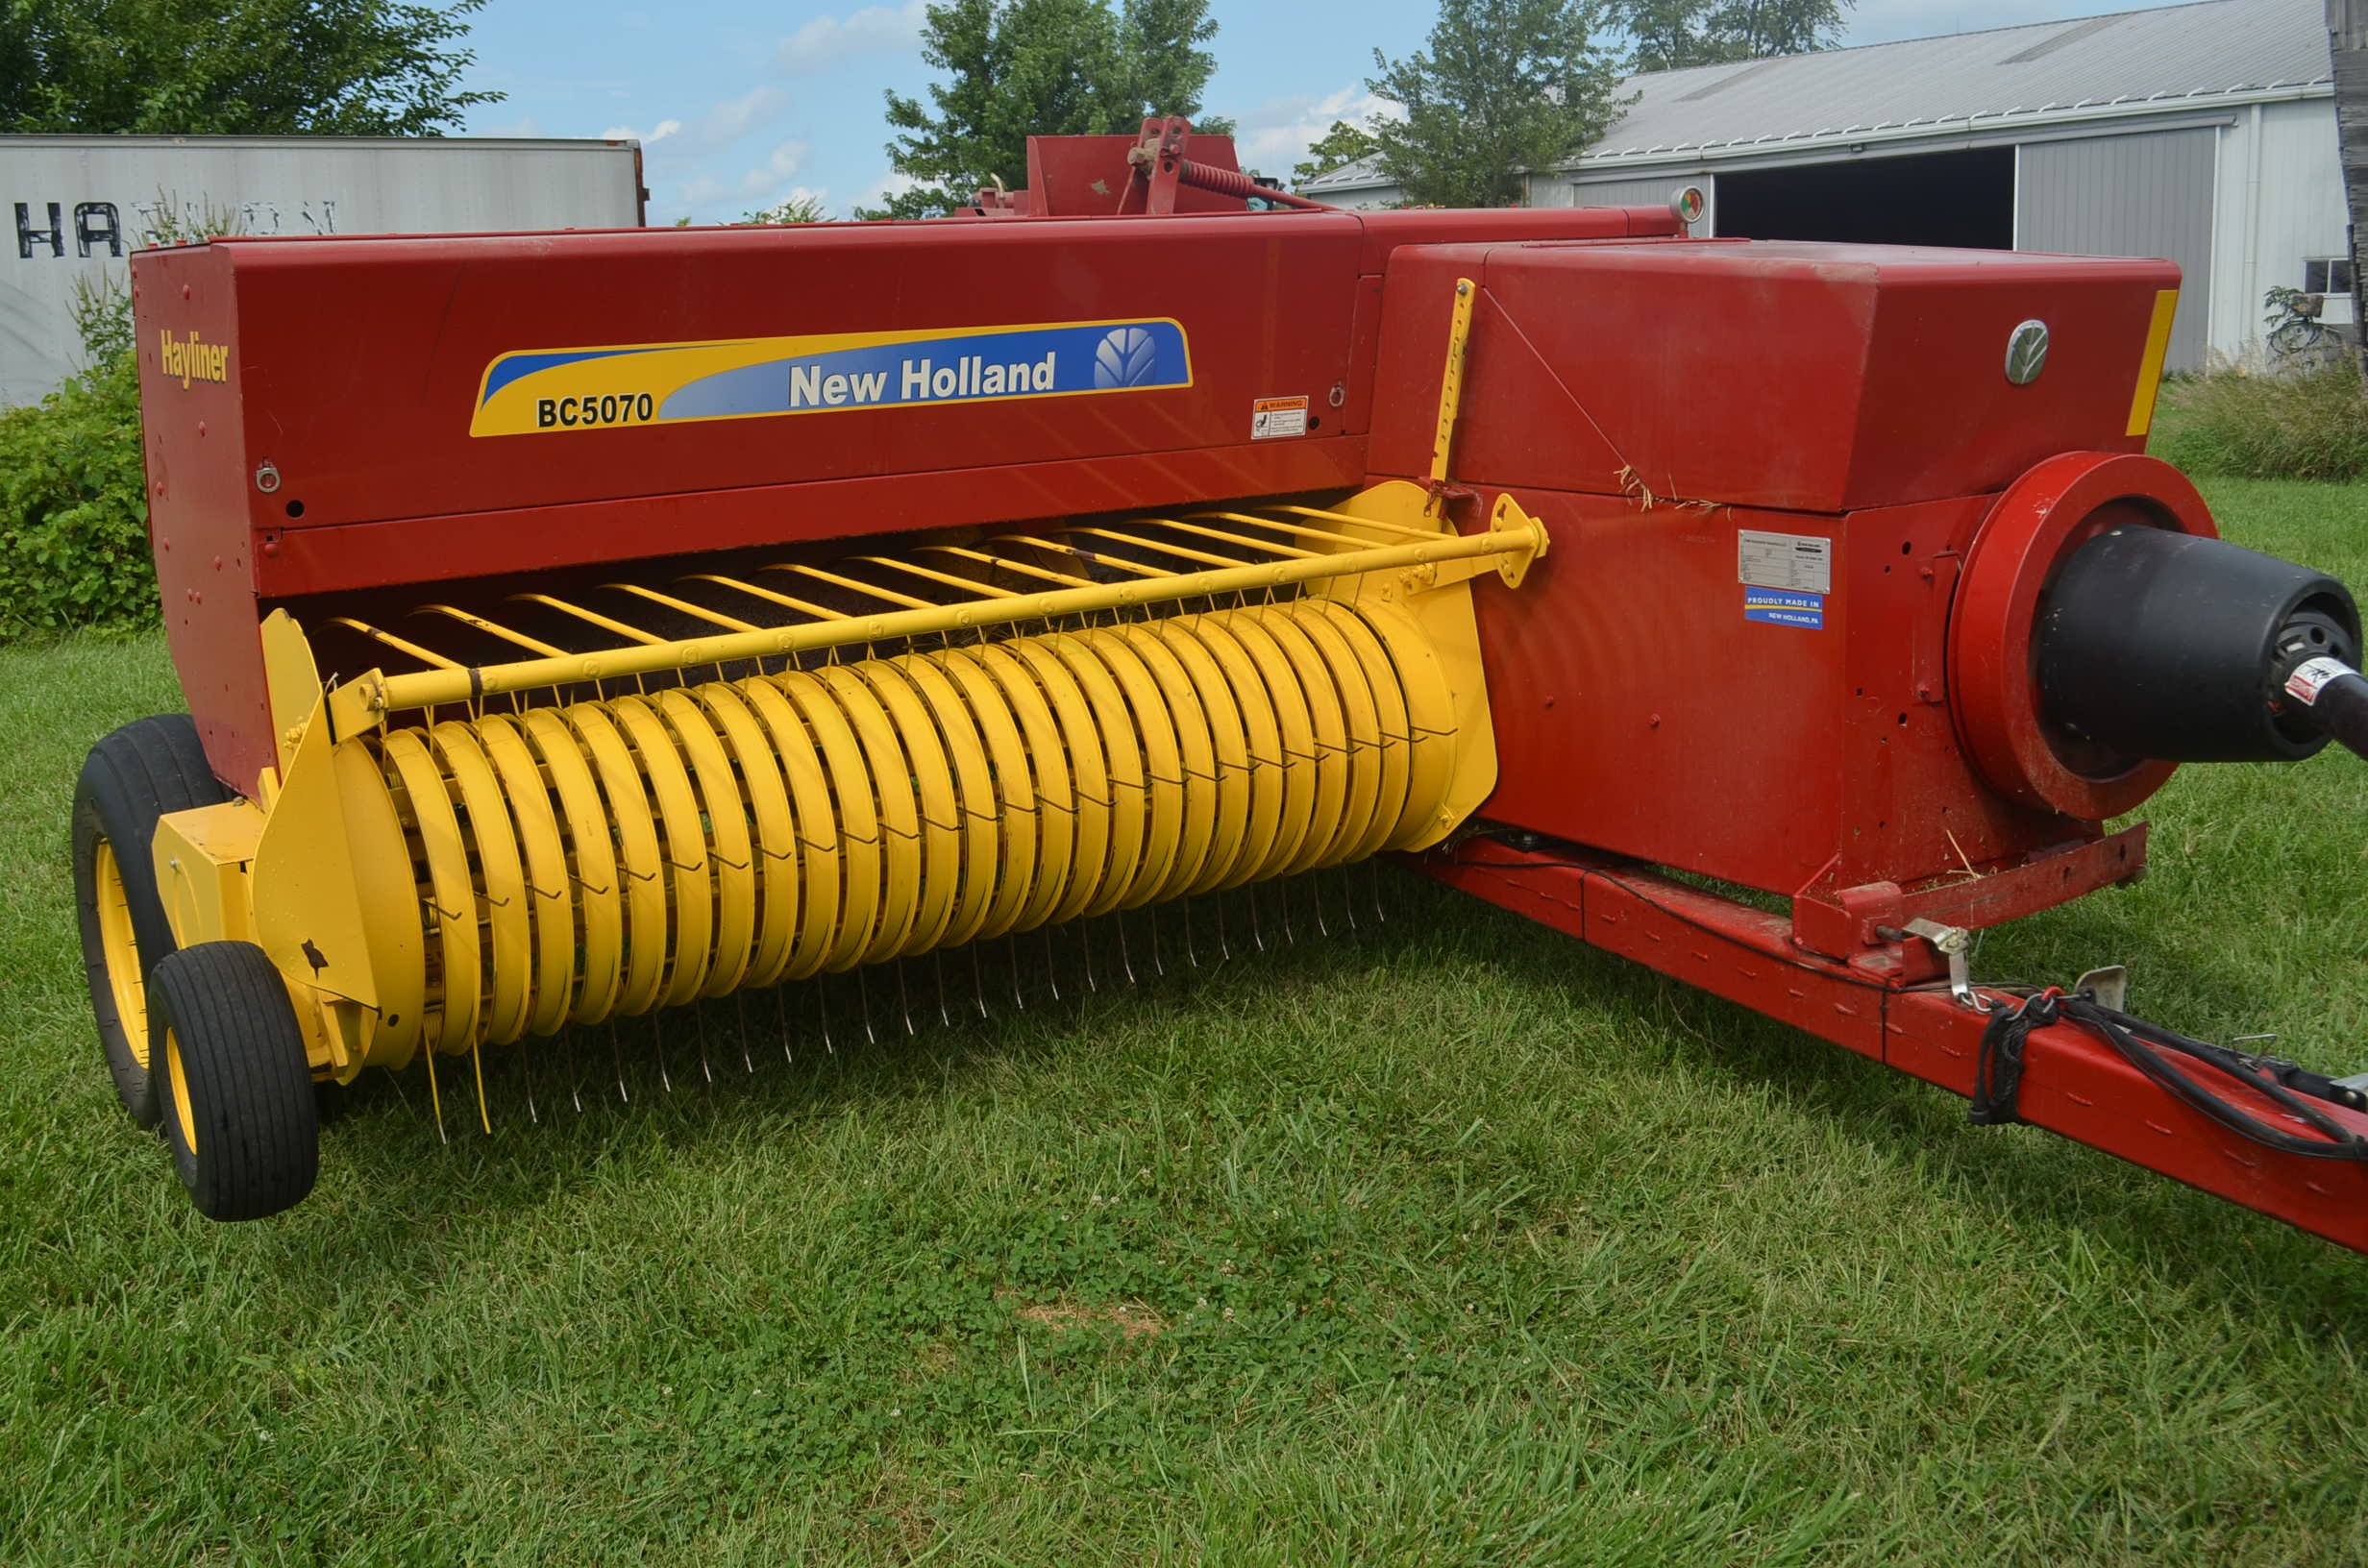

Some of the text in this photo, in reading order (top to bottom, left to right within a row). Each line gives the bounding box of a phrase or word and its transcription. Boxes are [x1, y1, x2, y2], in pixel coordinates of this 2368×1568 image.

[160, 330, 229, 390] Hayliner
[790, 352, 1055, 407] New Holland
[537, 393, 654, 428] BC5070
[1747, 597, 1783, 605] PROUDLY
